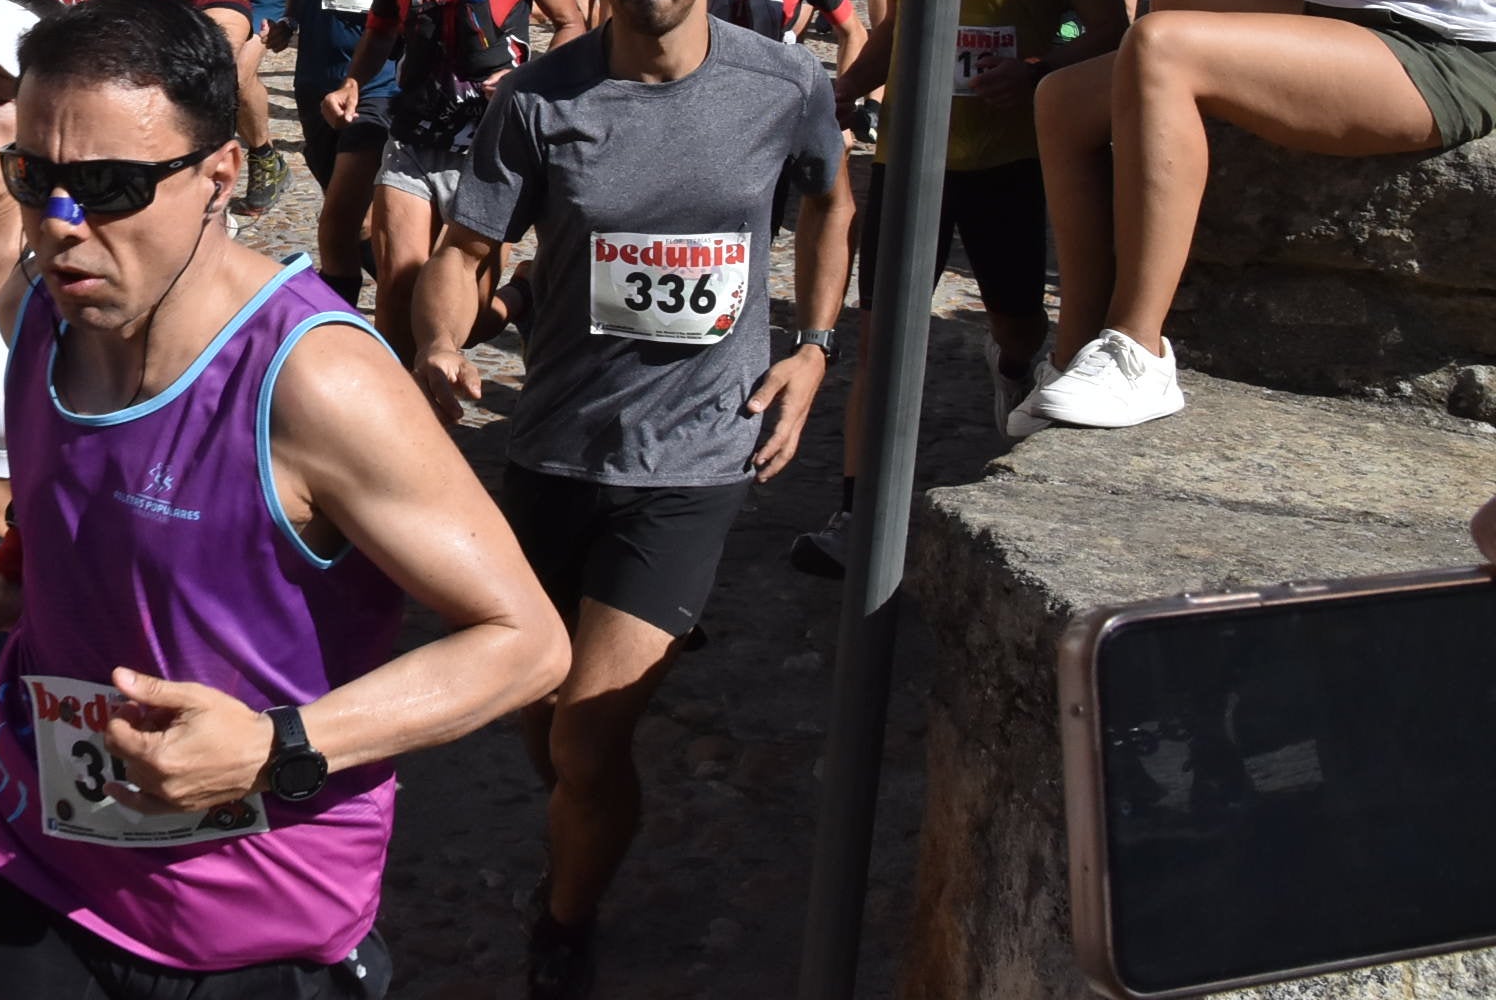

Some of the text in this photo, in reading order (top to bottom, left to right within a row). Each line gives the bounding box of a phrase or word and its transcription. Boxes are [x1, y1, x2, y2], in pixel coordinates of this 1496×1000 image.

[595, 238, 745, 268] bedunia
[624, 271, 717, 315] 336
[31, 682, 110, 734] bed
[71, 740, 126, 803] 3
